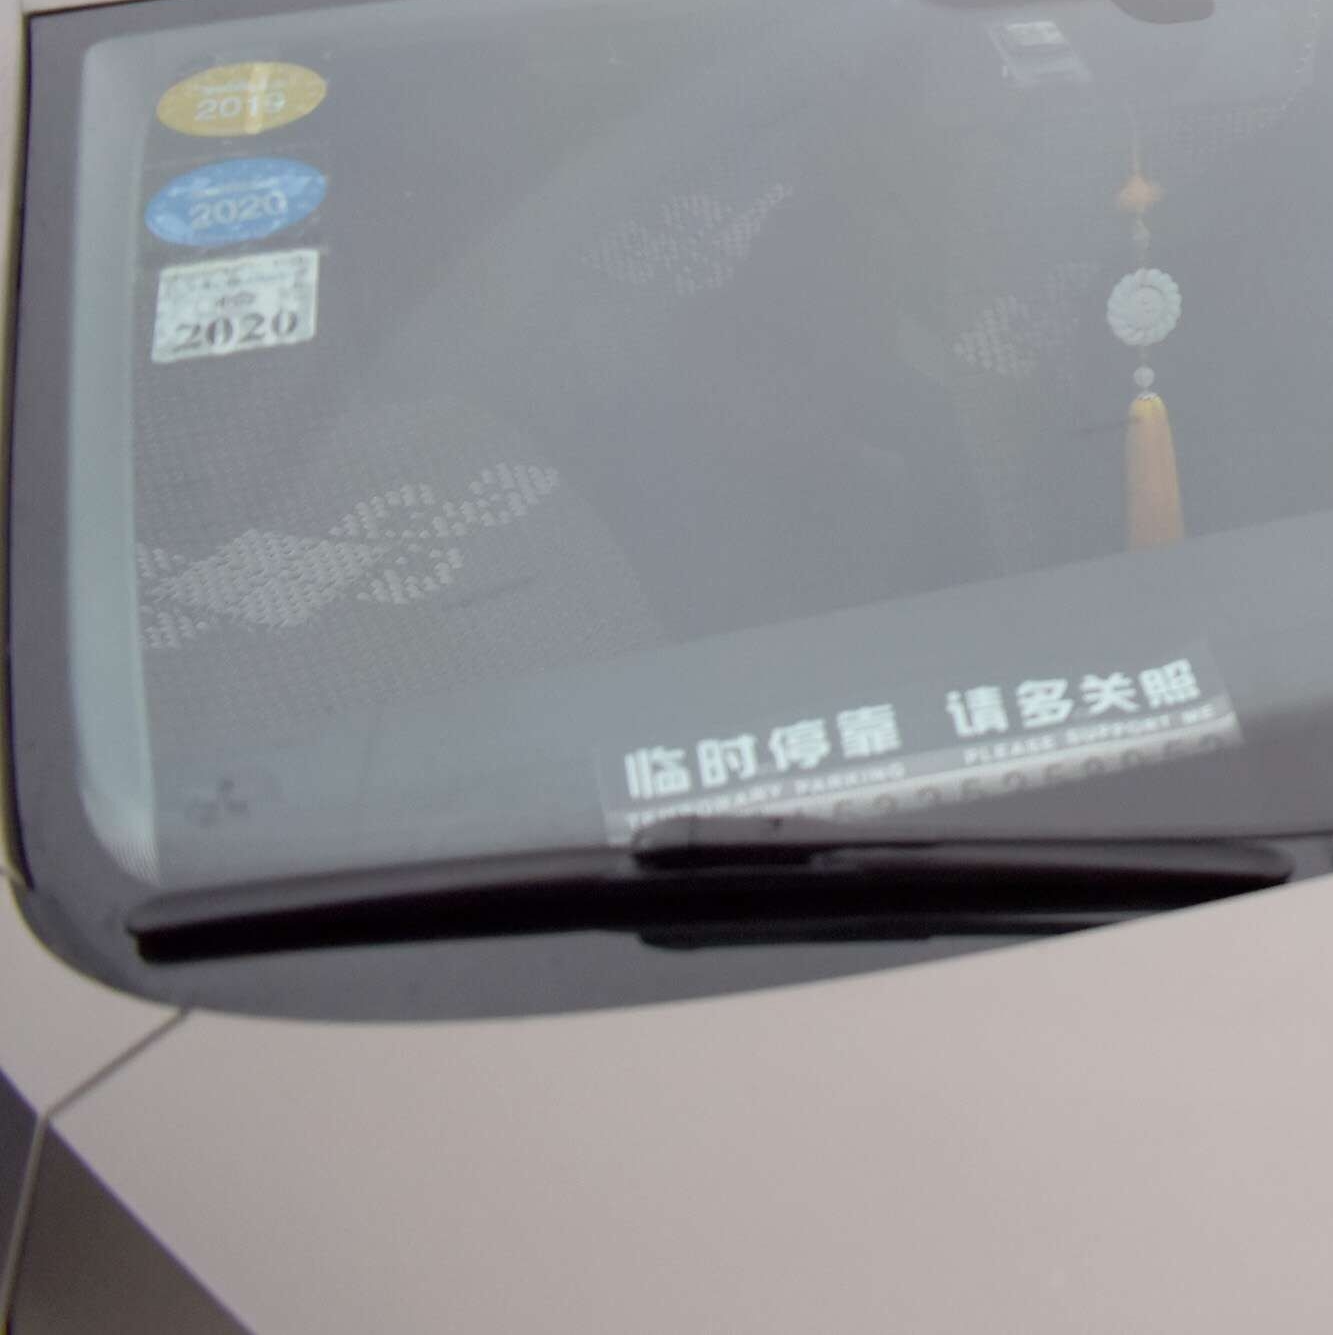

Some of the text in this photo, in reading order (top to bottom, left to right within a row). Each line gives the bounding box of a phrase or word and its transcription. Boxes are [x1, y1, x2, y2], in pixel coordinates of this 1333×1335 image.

[195, 93, 286, 122] 2019
[188, 192, 288, 230] 2020
[172, 309, 299, 353] 2020
[623, 658, 1201, 800] 临时停靠 请多关照
